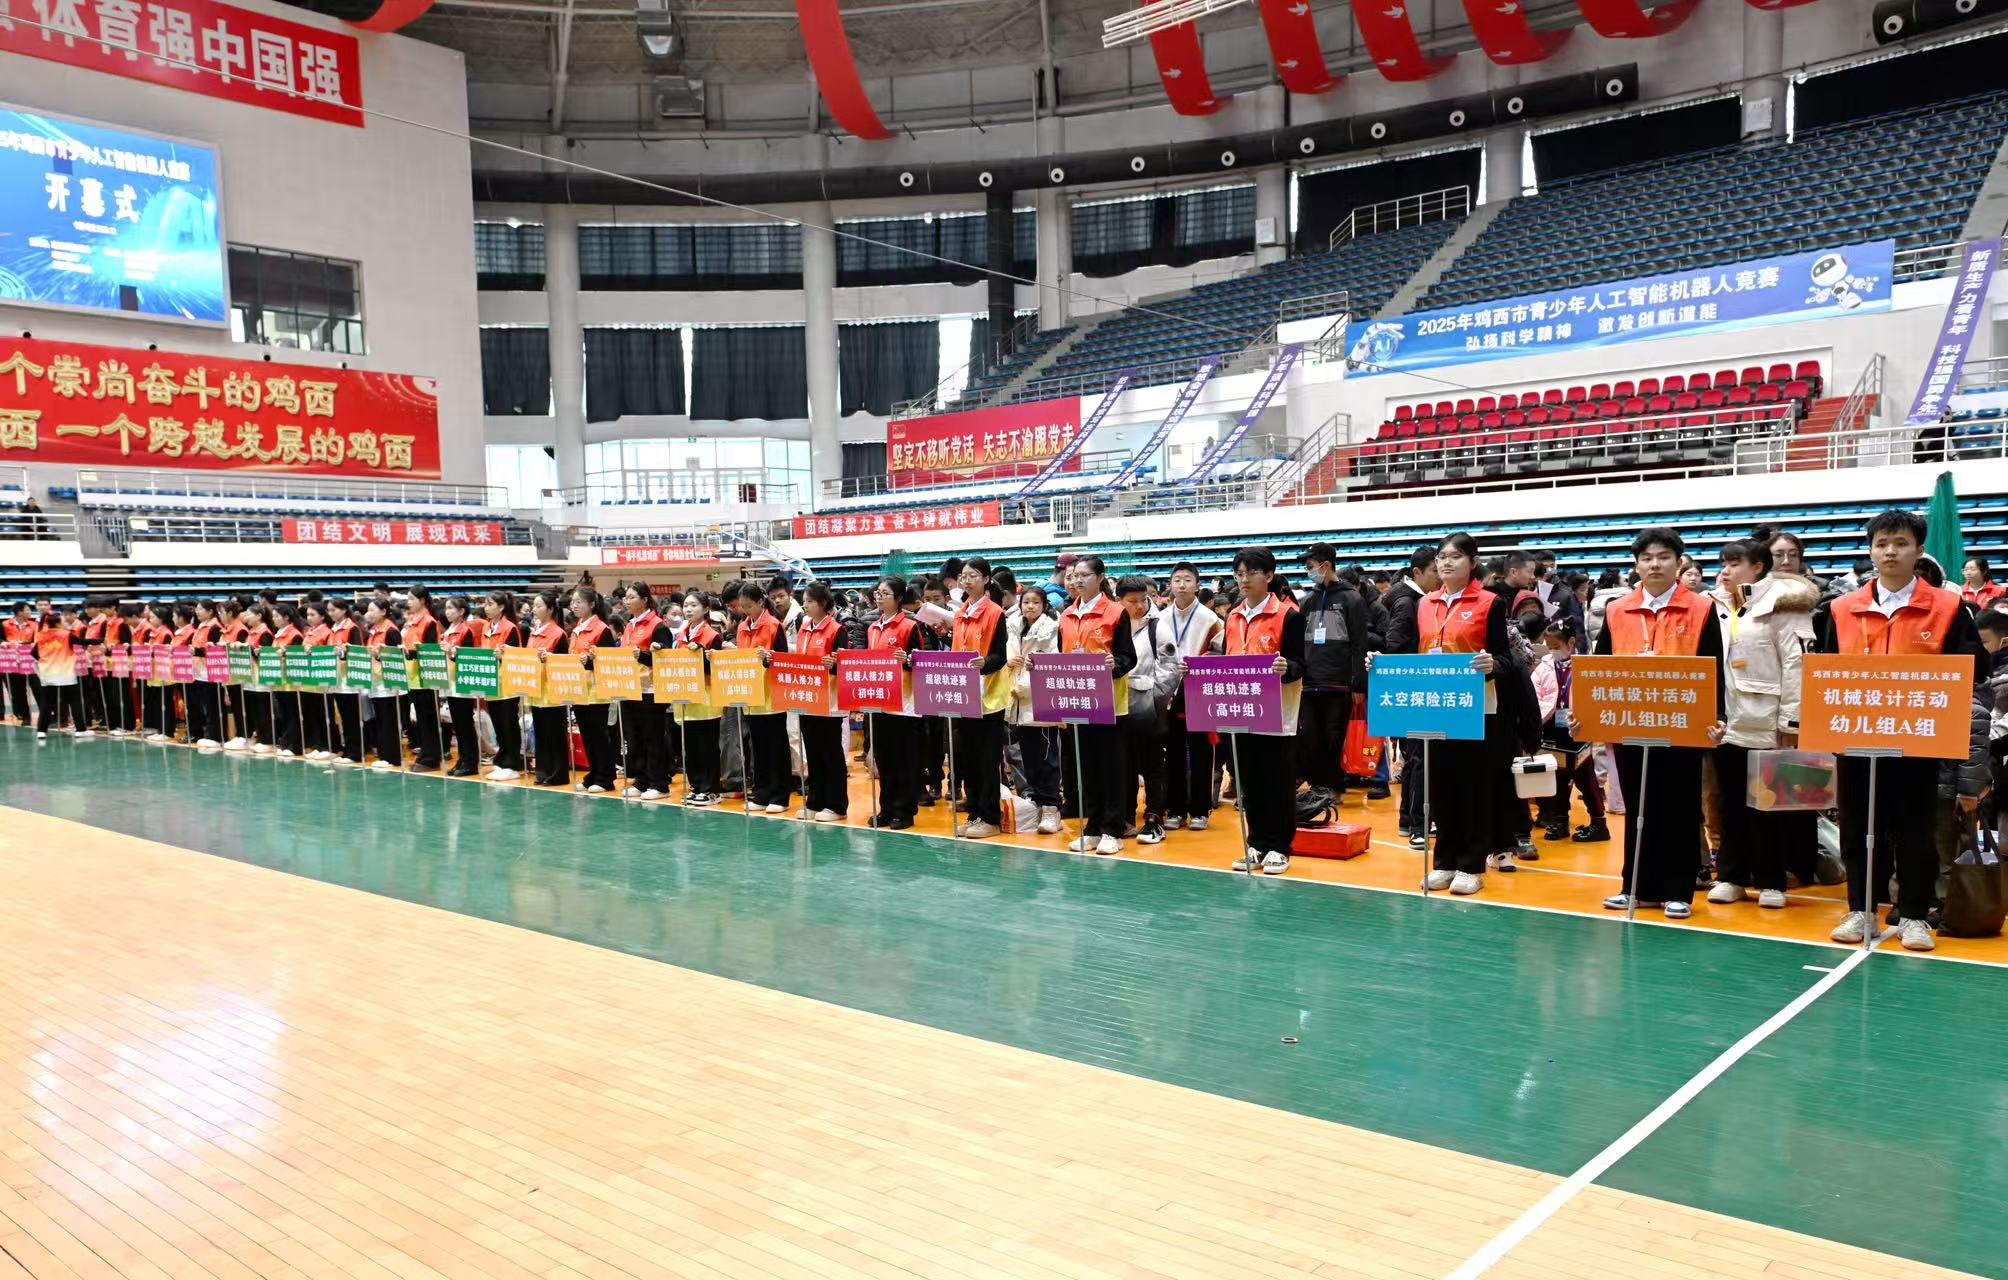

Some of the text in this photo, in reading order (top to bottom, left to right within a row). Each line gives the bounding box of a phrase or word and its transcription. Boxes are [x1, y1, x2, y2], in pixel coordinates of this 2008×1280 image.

[33, 0, 344, 104] 体育强中国强
[45, 172, 140, 224] 开幕式
[1418, 266, 1780, 335] 2025年鸡西市青少年人工智能机器人竞赛
[1466, 303, 1718, 352] 弘扬科学精神 激发创新潜能
[0, 351, 338, 418] 个崇尚奋斗的鸡西
[56, 413, 416, 471] 一个跨越发展的鸡西
[892, 421, 1075, 470] 坚定不移听党话 矢志不渝跟党走
[296, 520, 492, 544] 团结文明 展现风采
[804, 507, 984, 536] 团结凝聚力量 奋斗铸就伟业
[777, 673, 822, 687] 机器人接力赛
[845, 670, 894, 682] 机器人接力赛
[925, 673, 968, 687] 超级轨迹赛
[1189, 667, 1273, 676] 鸡西市青少年人工智能机器人竞赛
[1580, 670, 1707, 680] 鸡西市青少年人工智能机器人竞赛
[1812, 670, 1961, 681] 鸡西市青少年人工智能机器人竞赛
[1045, 677, 1096, 690] 超级轨迹赛
[1202, 681, 1262, 696] 超级轨迹赛
[1379, 691, 1474, 708] 太空探险活动
[1591, 686, 1698, 704] 机械设计活动
[1823, 687, 1949, 709] 机械设计活动
[1599, 709, 1689, 729] 幼儿组B组
[1829, 714, 1937, 737] 幼儿组A组
